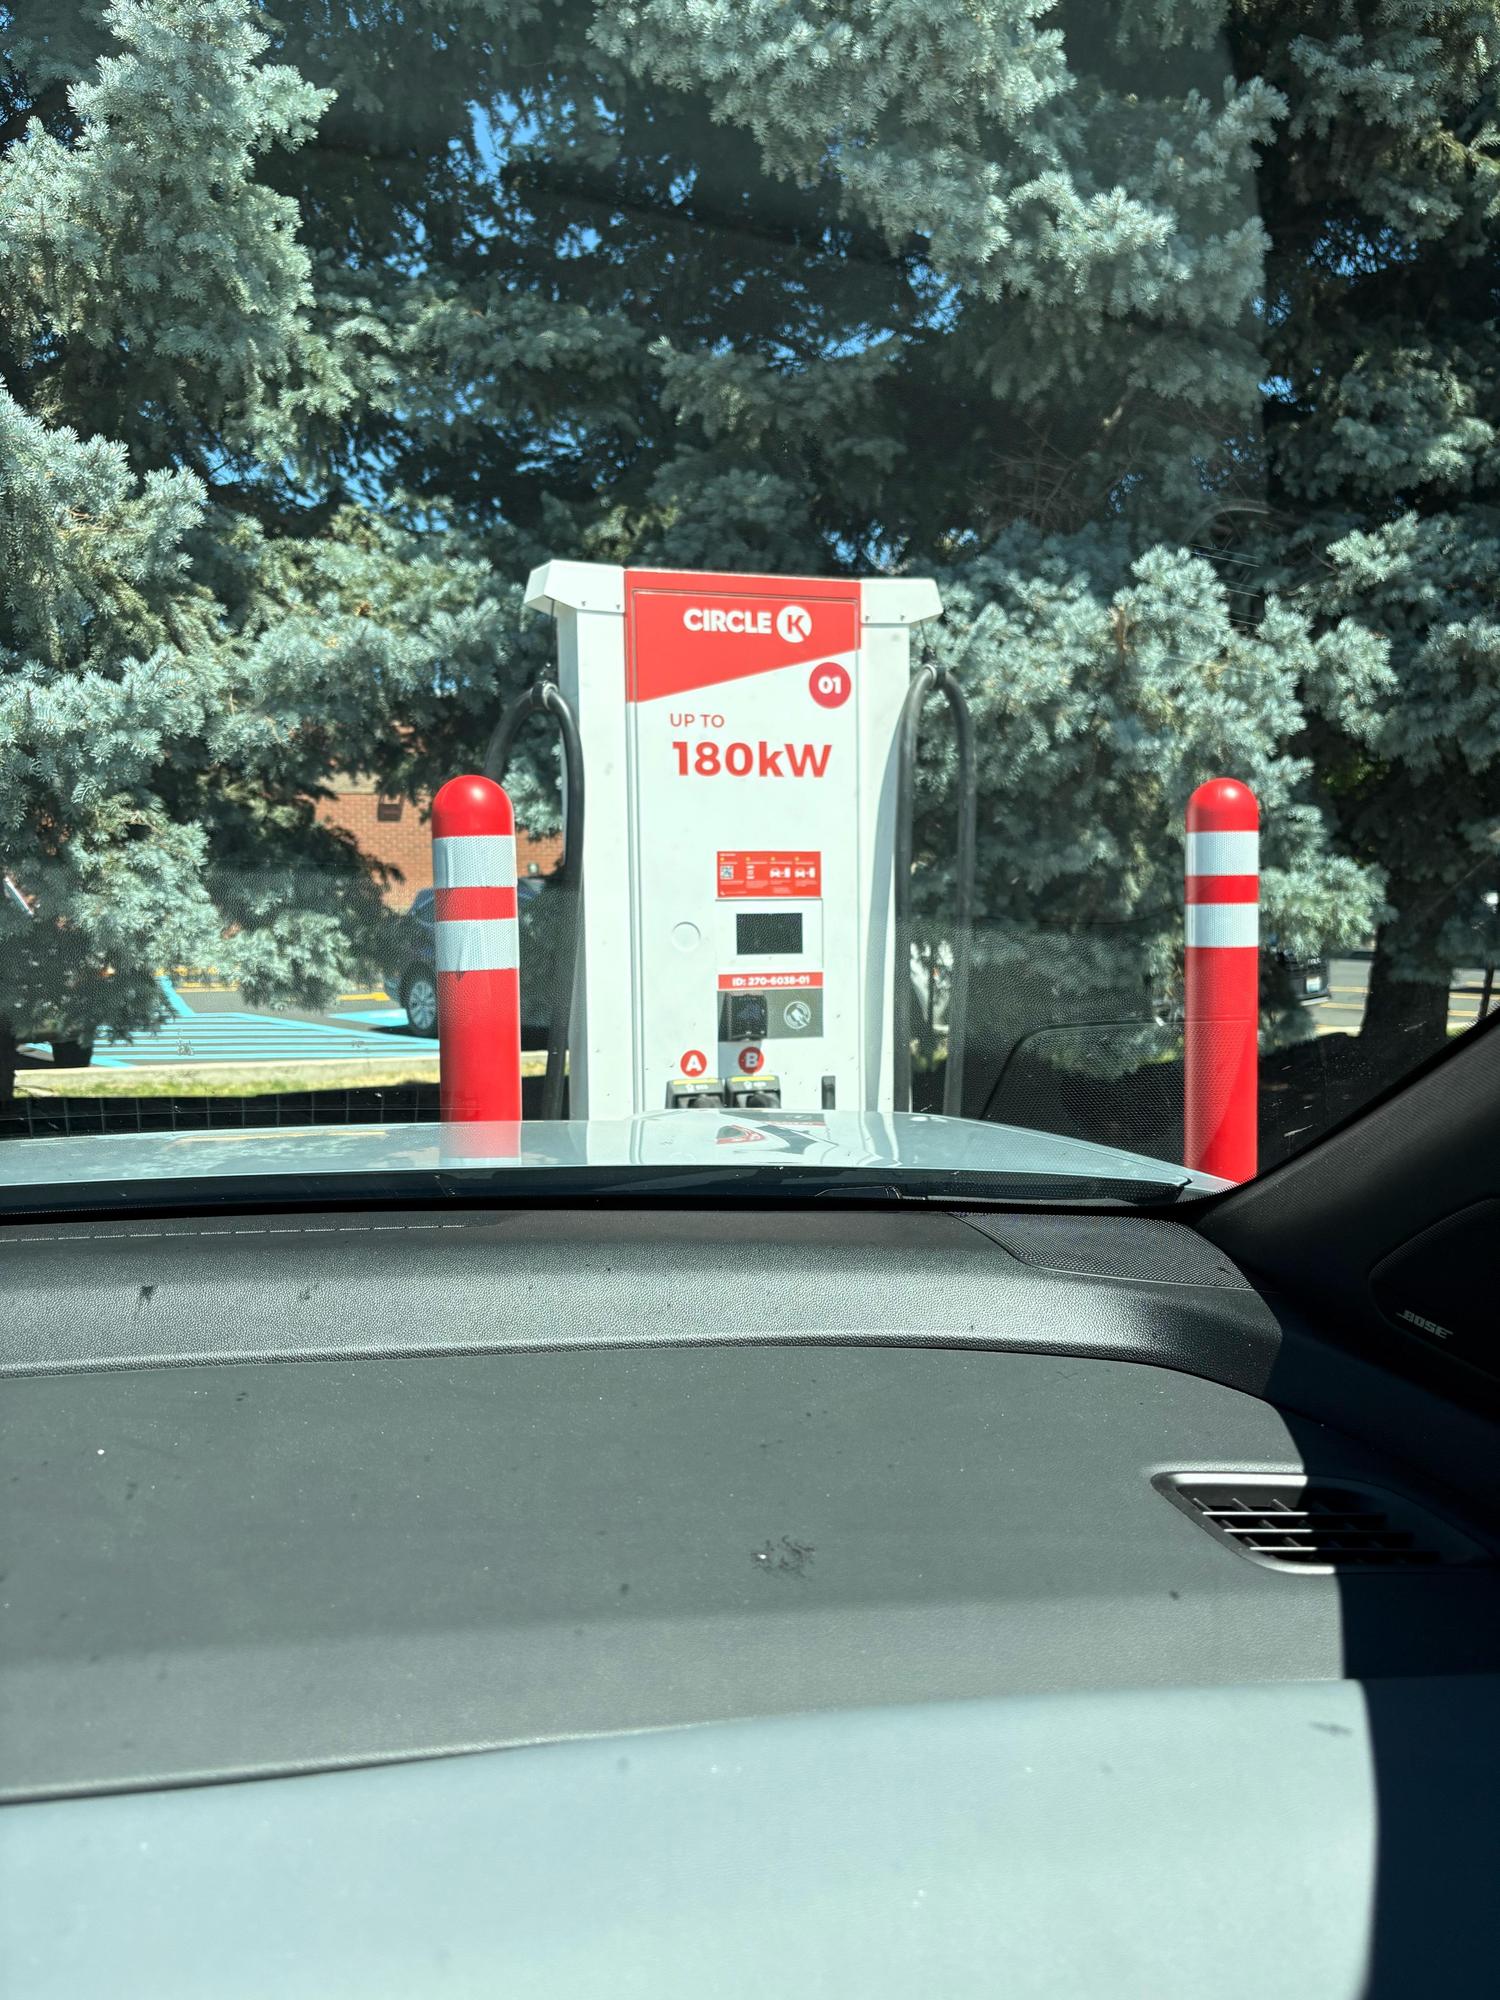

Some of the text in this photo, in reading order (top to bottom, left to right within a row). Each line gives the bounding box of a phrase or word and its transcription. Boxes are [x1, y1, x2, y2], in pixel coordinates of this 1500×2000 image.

[683, 607, 772, 635] CIRCLE
[818, 675, 842, 694] 01
[670, 713, 725, 728] UP TO
[672, 741, 832, 778] 180kW
[732, 978, 747, 987] ID:
[685, 1055, 702, 1071] A
[745, 1053, 759, 1068] B
[1395, 1309, 1454, 1339] BOSE
